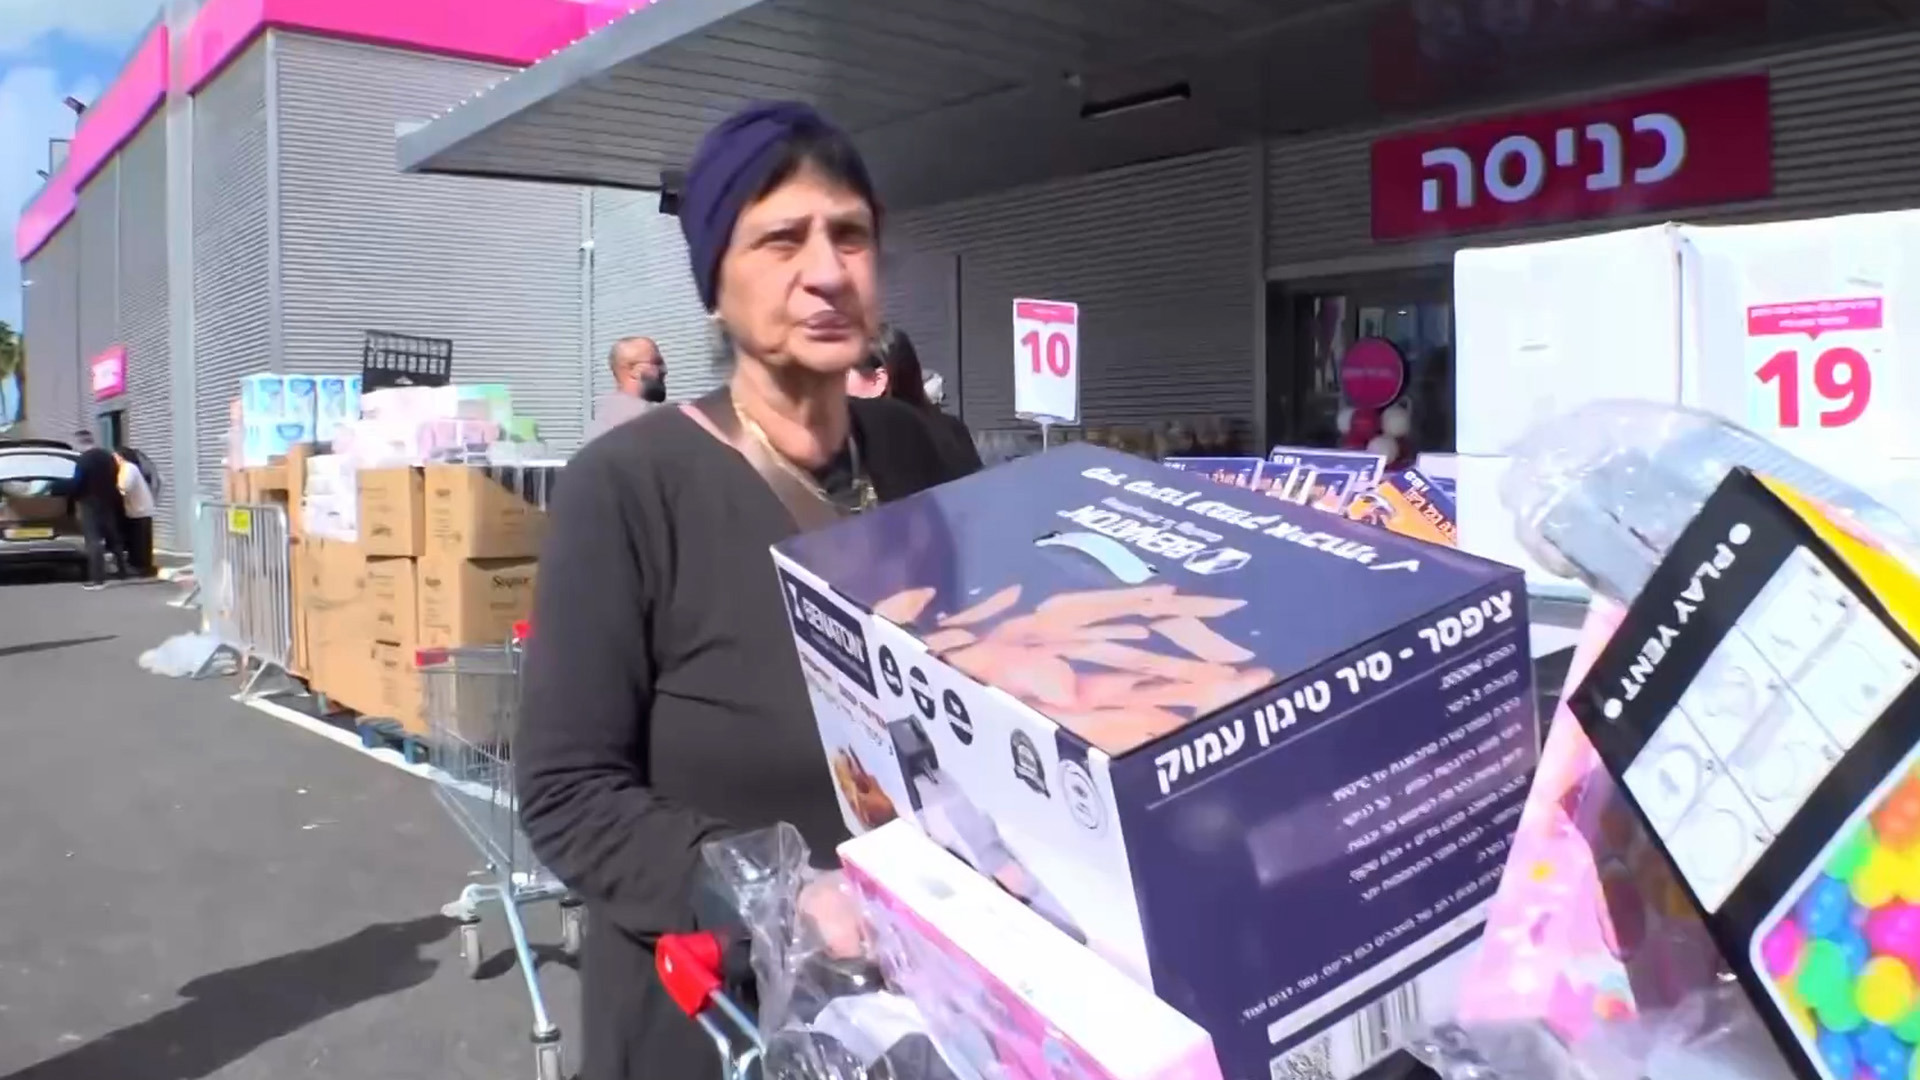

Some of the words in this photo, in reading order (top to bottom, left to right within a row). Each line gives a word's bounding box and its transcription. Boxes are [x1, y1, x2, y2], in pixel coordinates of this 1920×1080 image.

[1421, 112, 1687, 213] כניסה
[1020, 330, 1071, 379] 10
[1754, 346, 1872, 429] 19
[1062, 504, 1208, 560] BENATON
[1672, 542, 1737, 625] PLAY
[1418, 590, 1514, 654] ציפסר
[1335, 651, 1393, 694] סיר
[1253, 680, 1332, 747] טיגון
[1154, 719, 1247, 795] עמוק
